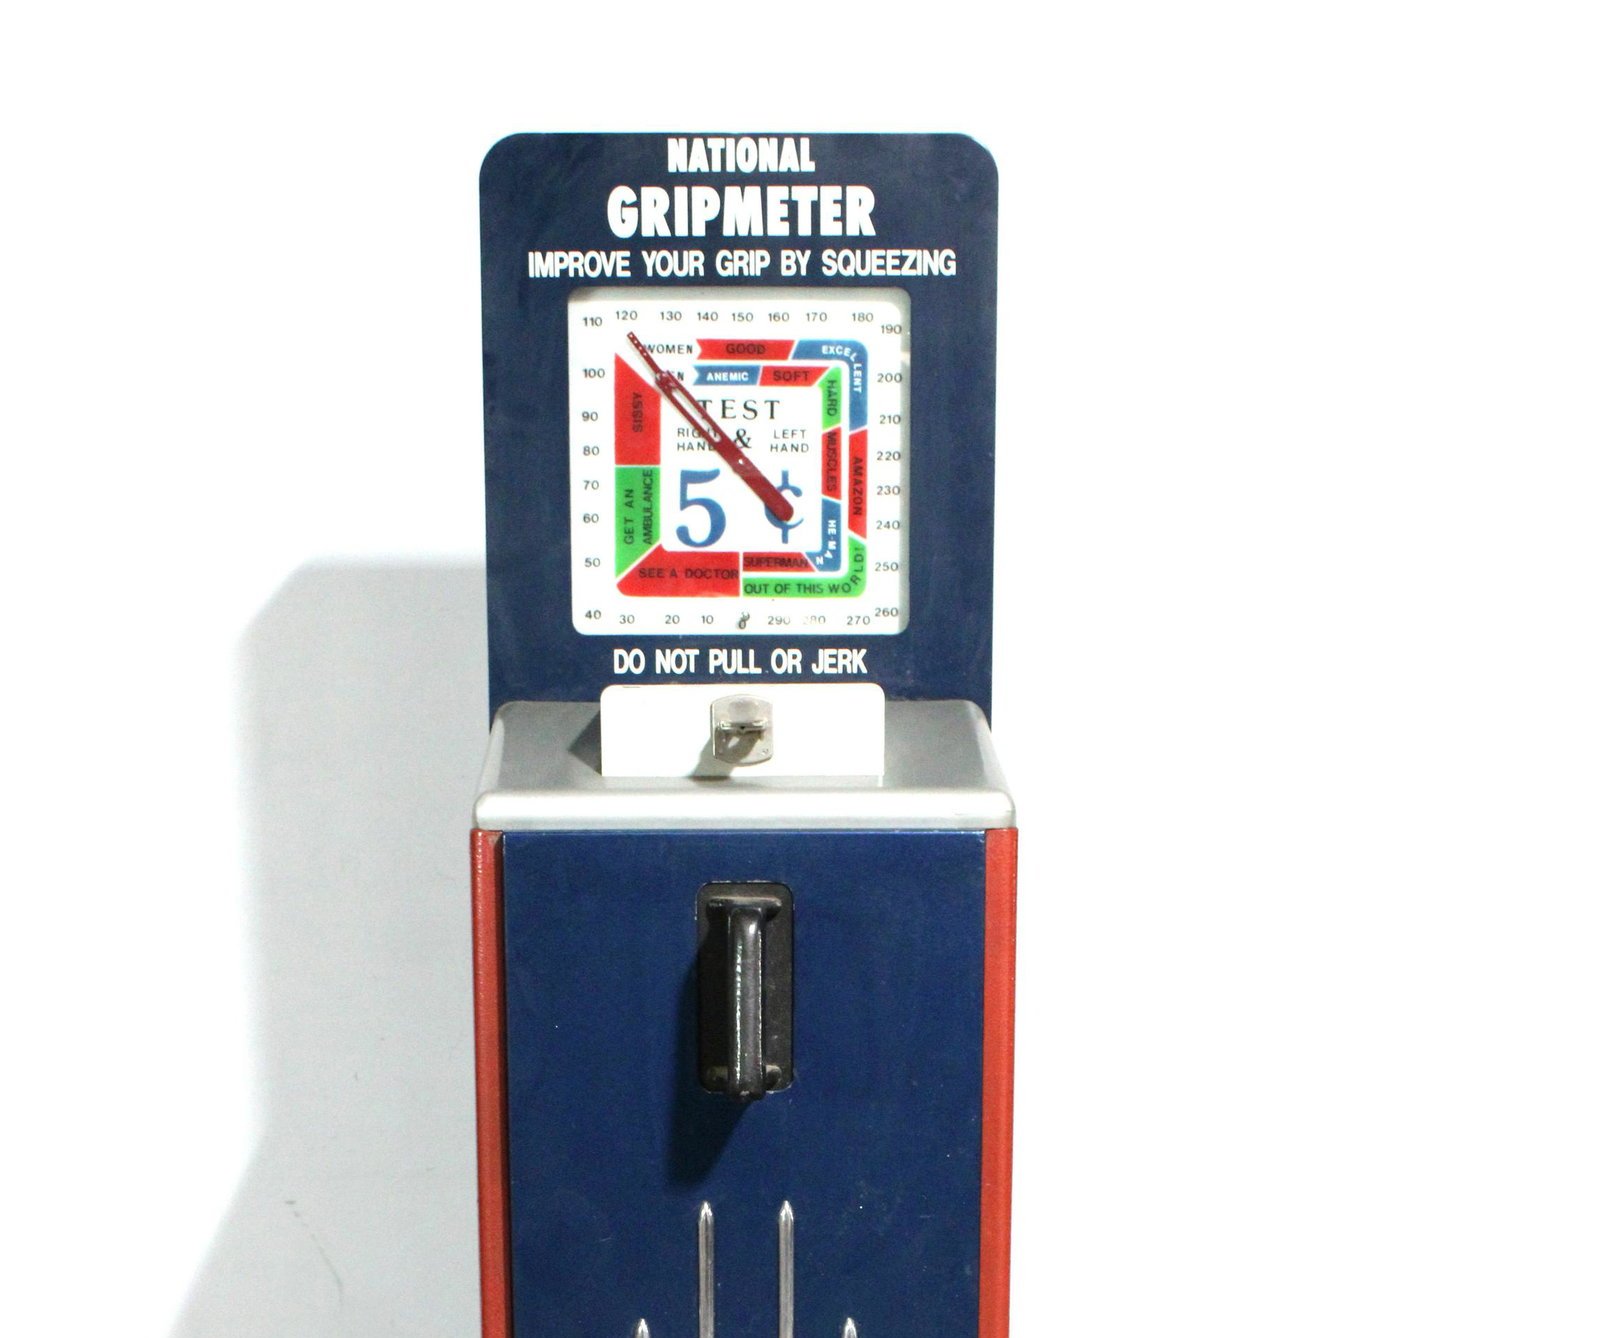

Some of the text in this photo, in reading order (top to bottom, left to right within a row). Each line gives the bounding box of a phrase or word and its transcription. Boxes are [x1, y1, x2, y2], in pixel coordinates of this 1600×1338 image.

[668, 137, 815, 173] NATIONAL
[607, 185, 876, 239] GRIPMETER
[528, 248, 957, 278] IMPROVE YOUR GRIP BY SQUEEZING
[616, 310, 874, 322] 120 130 140 150 160 170 180
[583, 317, 603, 327] 110
[881, 324, 903, 334] 190
[643, 344, 693, 354] WOMEN
[726, 343, 766, 355] GOOD
[583, 368, 605, 378] 100
[706, 372, 748, 381] ANEMIC
[773, 370, 810, 382] SOFT
[877, 373, 903, 383] 200
[827, 380, 838, 417] HARD
[581, 411, 599, 421] 90
[632, 392, 643, 433] SISSY
[879, 414, 901, 424] 210
[733, 428, 752, 448] &
[774, 429, 807, 439] LEFT
[583, 445, 600, 456] 80
[770, 443, 809, 453] HAND
[826, 431, 838, 491] MUSCLES
[877, 451, 901, 461] 220
[583, 480, 600, 490] 70
[853, 457, 863, 516] AMAZON
[877, 485, 901, 495] 230
[643, 469, 653, 545] AMBULANCE
[676, 468, 726, 548] 5
[583, 513, 600, 523] 60
[624, 489, 634, 545] GET AN
[876, 520, 901, 530] 240
[584, 557, 601, 567] 50
[743, 555, 809, 568] SUPERMAN
[874, 562, 899, 572] 250
[639, 568, 739, 580] SEE A DOCTOR
[744, 583, 769, 595] OUT
[774, 583, 790, 594] OF
[796, 583, 823, 593] THIS
[585, 610, 602, 620] 40
[875, 607, 899, 617] 260
[619, 615, 635, 625] 30
[665, 615, 680, 625] 20
[701, 615, 714, 624] 10
[767, 615, 791, 625] 290
[846, 615, 870, 625] 270
[613, 648, 868, 675] DO NOT PULL OR JERK
